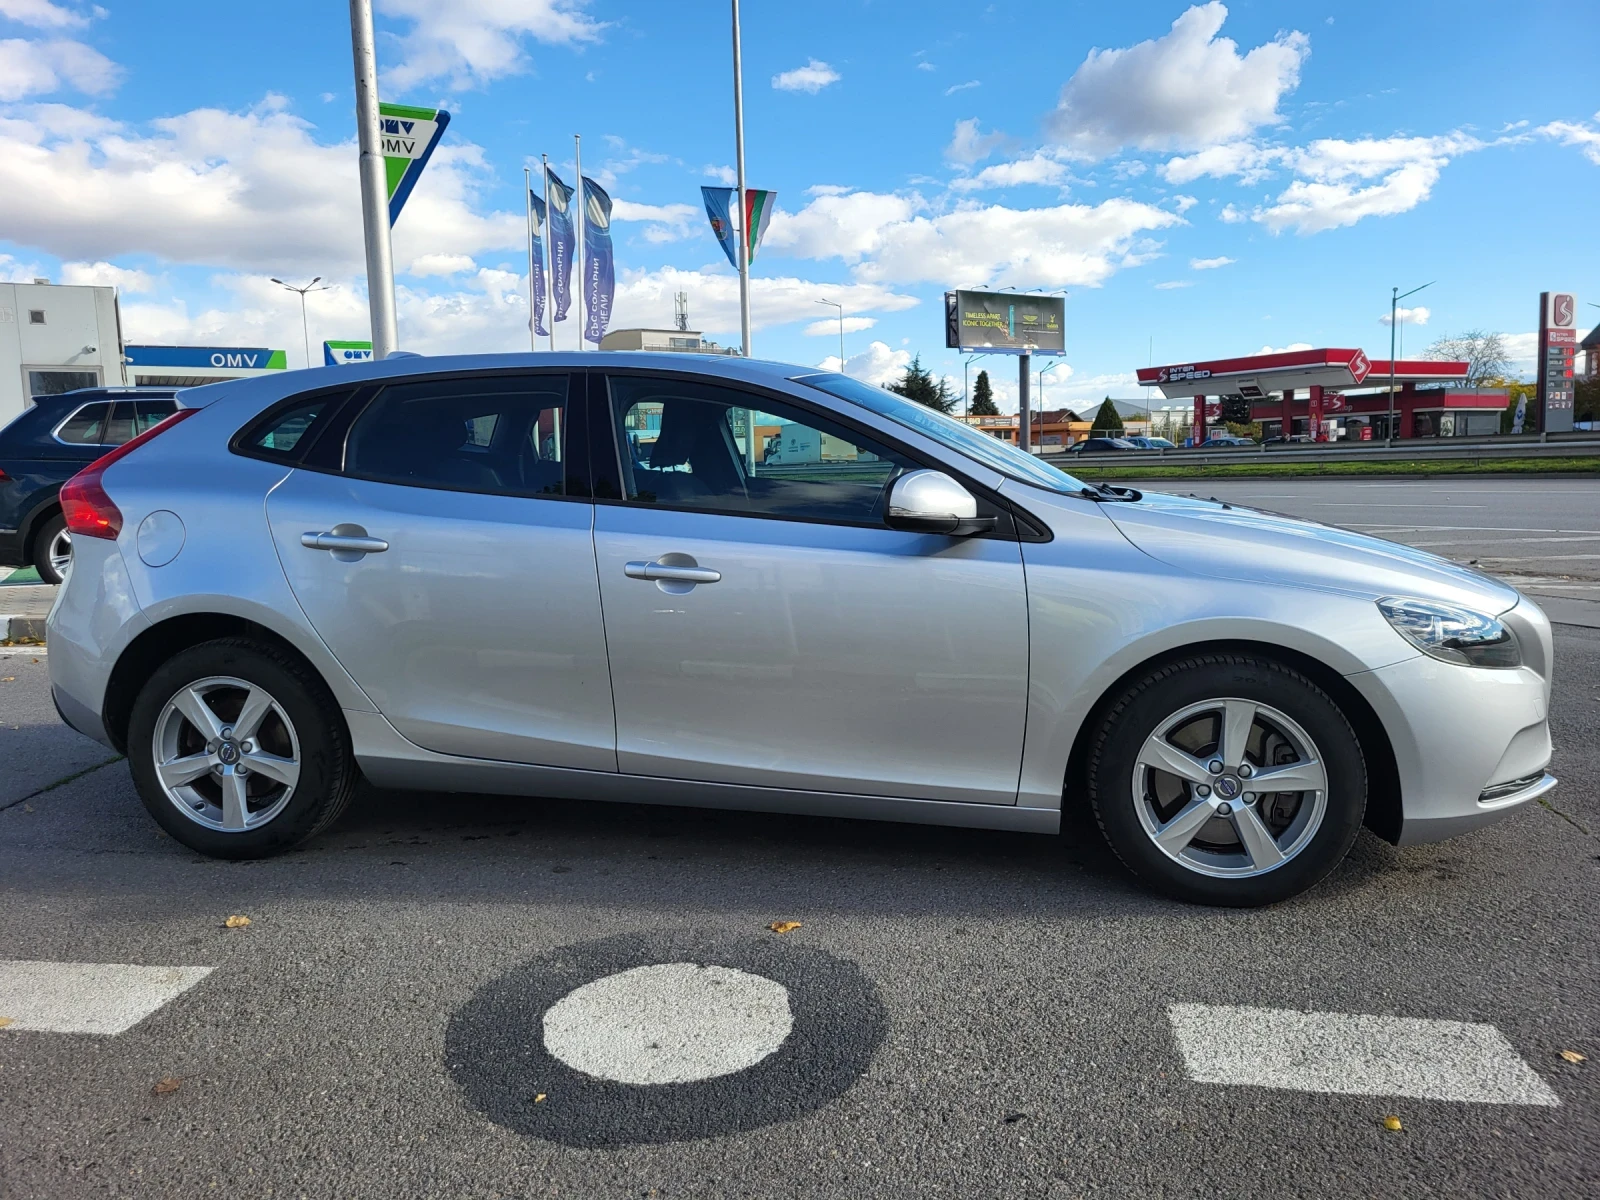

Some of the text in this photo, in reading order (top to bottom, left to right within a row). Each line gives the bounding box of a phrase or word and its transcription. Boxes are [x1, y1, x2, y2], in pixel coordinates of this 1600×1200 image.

[380, 118, 415, 135] MV
[381, 138, 415, 154] MV
[590, 257, 600, 337] СЪС СОЛАРНИ
[211, 353, 258, 367] OMV
[1169, 365, 1194, 373] INTER
[1169, 370, 1211, 381] SPEED
